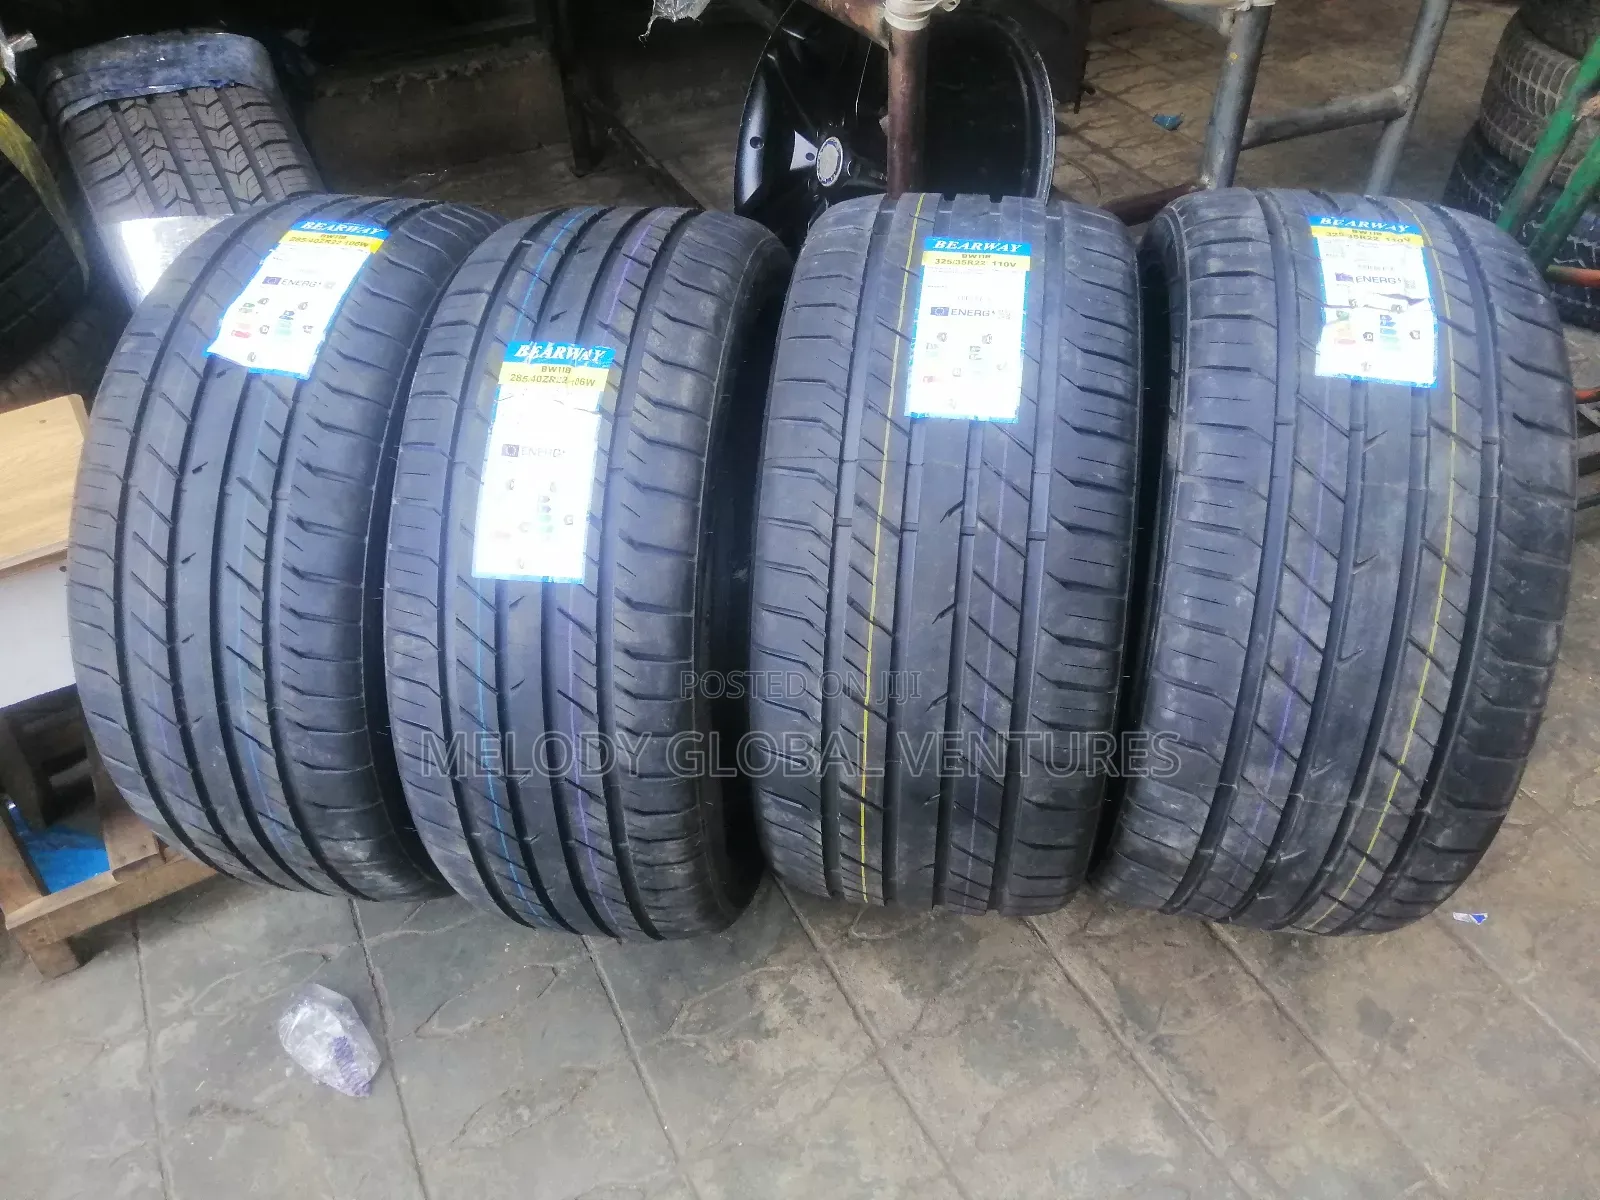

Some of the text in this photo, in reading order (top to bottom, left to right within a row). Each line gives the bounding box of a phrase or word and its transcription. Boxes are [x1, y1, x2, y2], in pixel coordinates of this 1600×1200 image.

[301, 221, 384, 235] BEARWAY
[1320, 217, 1410, 232] BEARWAY
[933, 240, 1023, 253] BEARWAY
[934, 258, 986, 266] 325/35R22
[514, 343, 607, 363] BEARWAY
